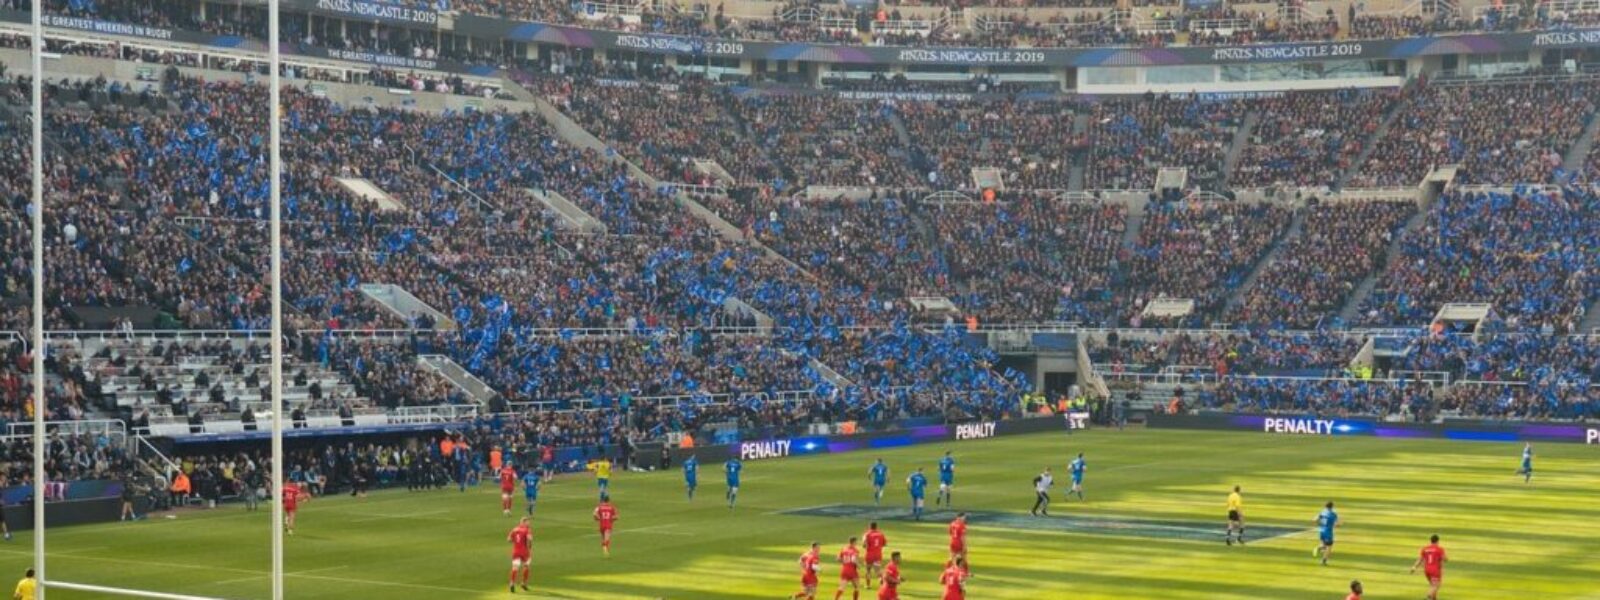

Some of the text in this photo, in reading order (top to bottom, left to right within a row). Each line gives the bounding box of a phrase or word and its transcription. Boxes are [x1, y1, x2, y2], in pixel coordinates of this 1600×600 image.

[353, 2, 410, 20] NEWCASTLE
[413, 10, 436, 23] 2019
[53, 16, 92, 29] GREATEST
[95, 21, 133, 35] WEEKEND
[136, 27, 144, 36] IN
[145, 28, 172, 39] RUGBY
[616, 35, 649, 48] FINALS
[716, 43, 743, 54] 2019
[1532, 32, 1577, 45] FINALS
[328, 49, 340, 58] THE
[342, 50, 374, 61] GREATEST
[899, 50, 1044, 62] FINALS NEWCASTLE 2019
[1212, 43, 1362, 60] FINALS NEWCASTLE 2019
[839, 91, 853, 99] THE
[956, 422, 995, 439] PENALTY
[1264, 418, 1334, 434] PENALTY
[1587, 429, 1600, 444] P
[741, 440, 791, 460] PENALTY
